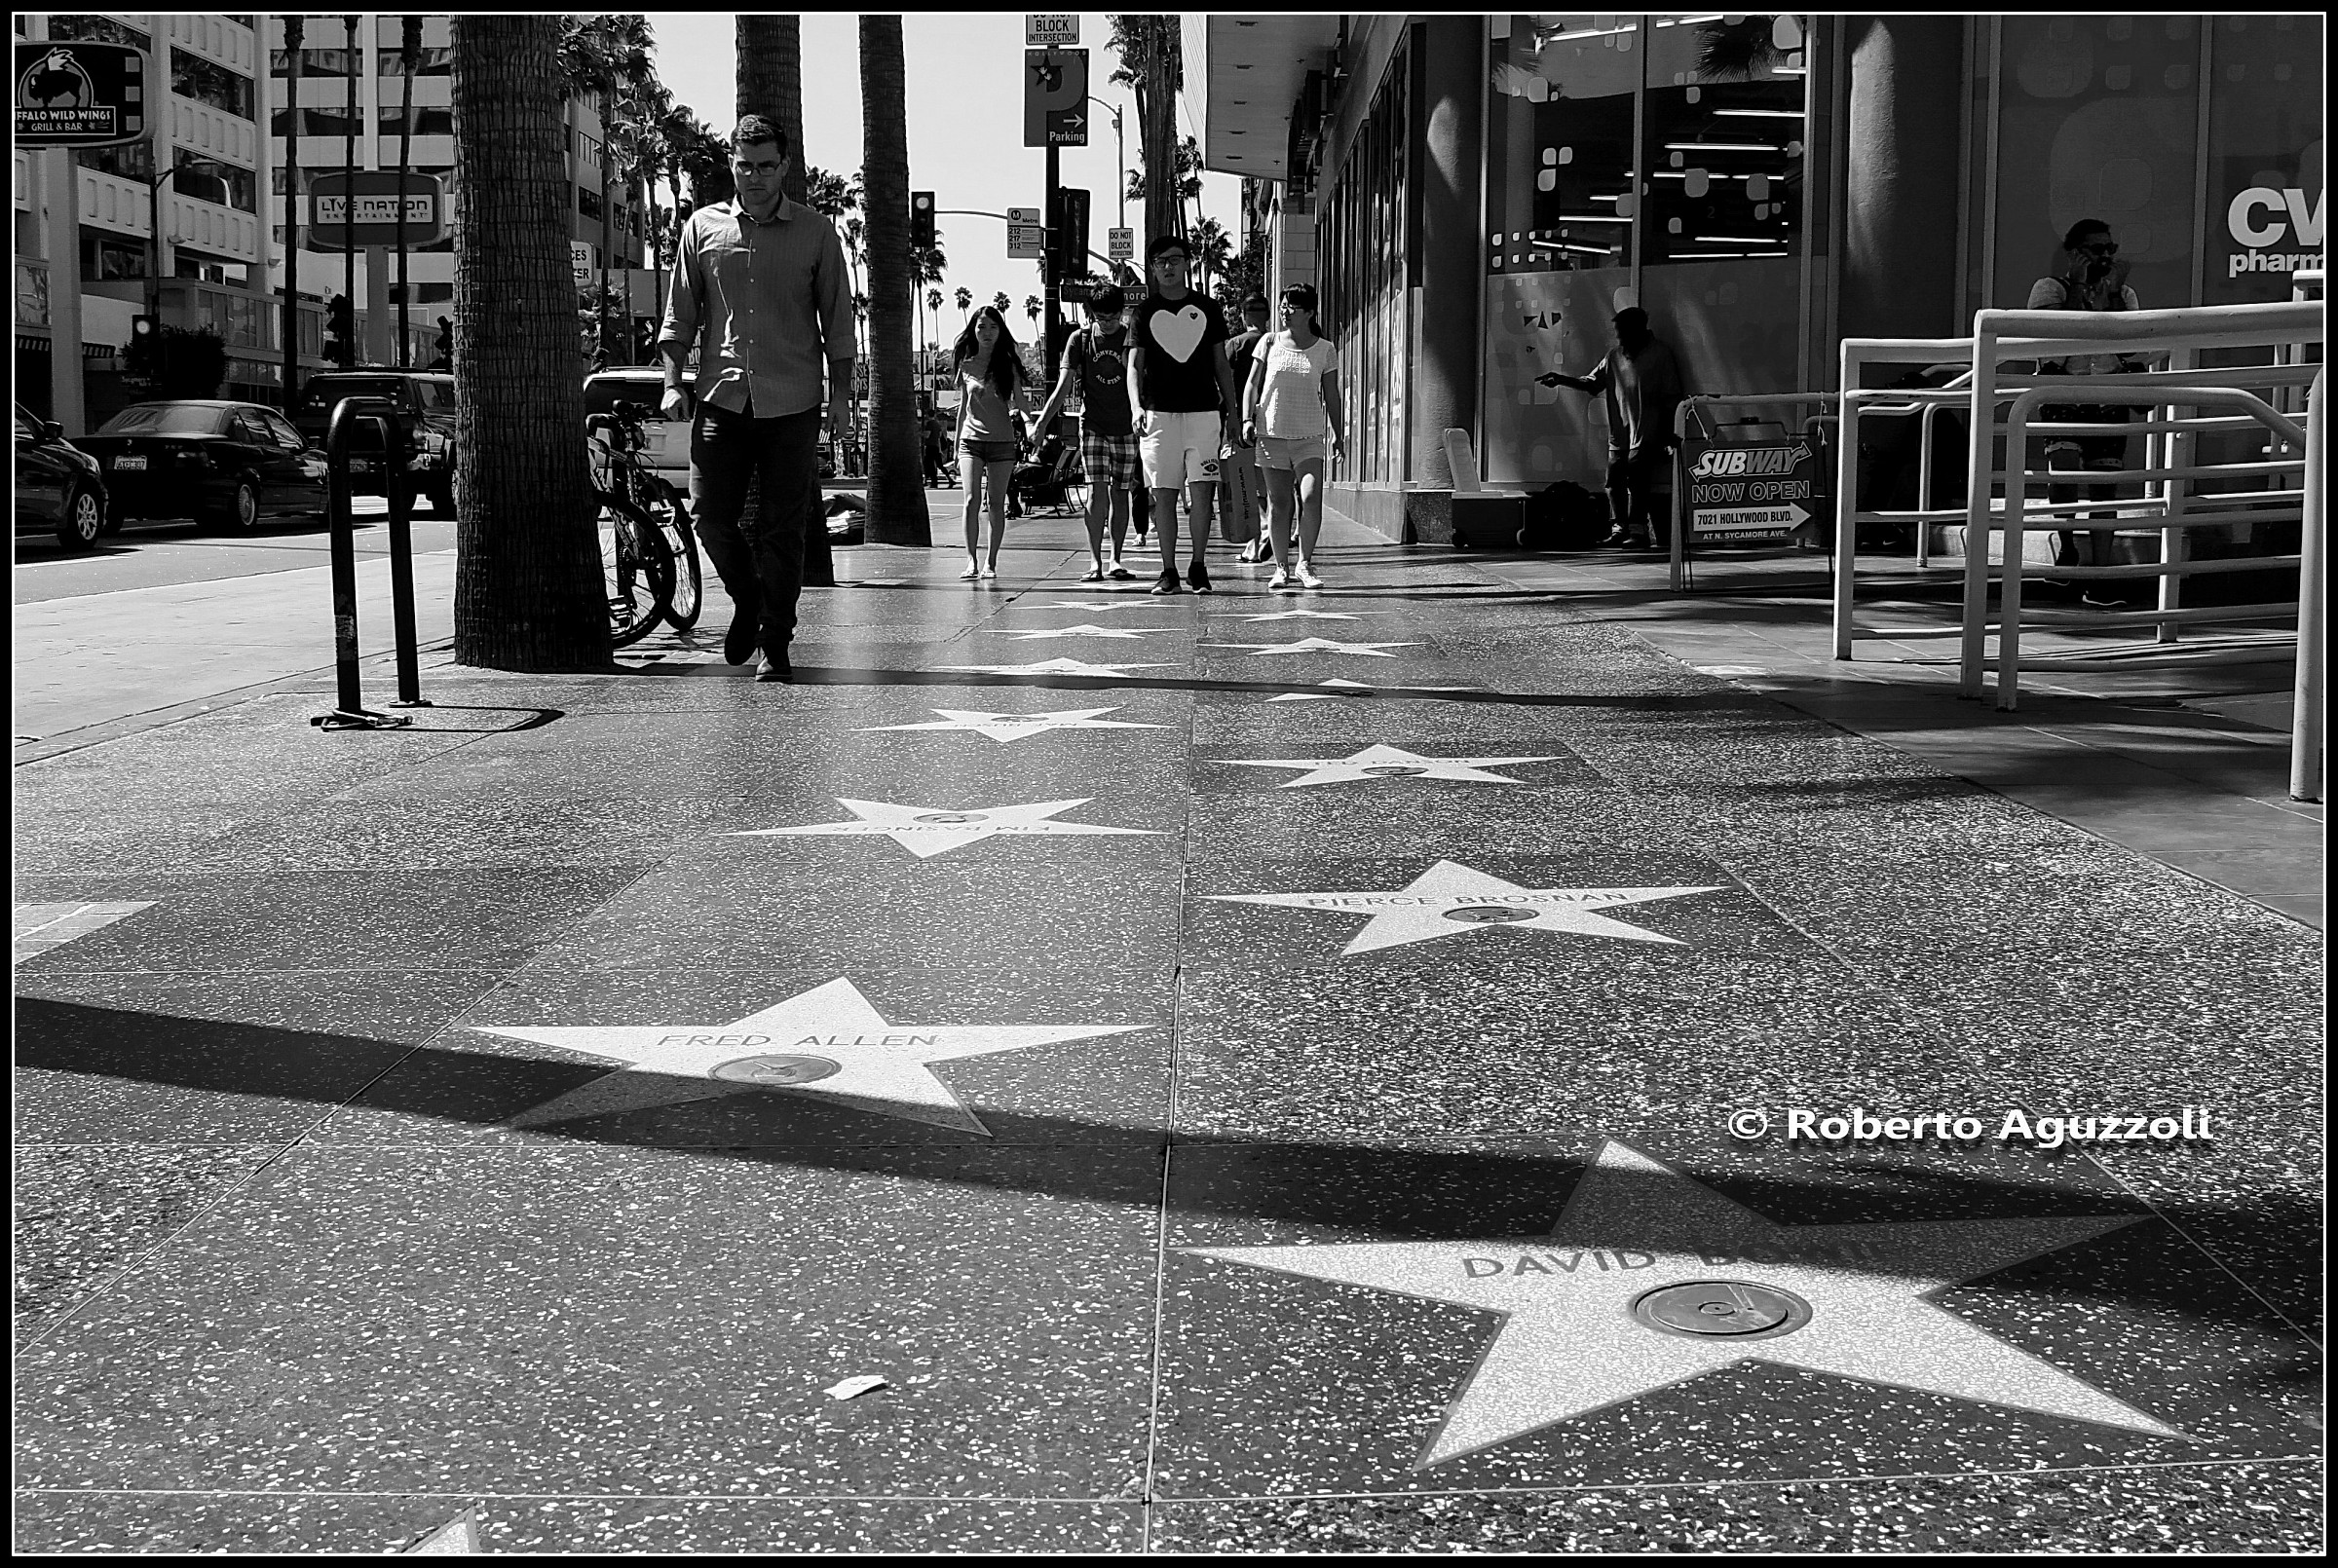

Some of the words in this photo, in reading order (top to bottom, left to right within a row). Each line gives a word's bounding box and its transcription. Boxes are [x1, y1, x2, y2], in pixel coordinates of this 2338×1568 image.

[1036, 19, 1070, 32] BLOCK
[1029, 32, 1077, 43] INTERSECTION
[50, 110, 76, 121] WILD
[78, 110, 111, 121] WINGS
[31, 123, 55, 131] GRILL
[56, 123, 62, 131] &
[64, 123, 83, 131] BAR
[1049, 131, 1085, 144] Parking
[363, 200, 428, 210] NATON
[1120, 231, 1132, 240] NOT
[574, 268, 590, 280] ER
[1690, 444, 1810, 479] SUBWAY
[1691, 483, 1746, 504] NOW
[1749, 480, 1810, 502] OPEN
[1697, 513, 1717, 526] 7021
[1719, 511, 1769, 525] HOLLYWOOD
[1770, 510, 1793, 522] BLVD.
[1702, 532, 1713, 541] AT
[1724, 531, 1768, 540] SYCAMORE
[1307, 897, 1438, 908] PIERCE
[1455, 892, 1629, 905] BROSNAN
[657, 1034, 772, 1046] FRED
[794, 1034, 938, 1046] ALLEN
[1462, 1249, 1656, 1279] DAVID
